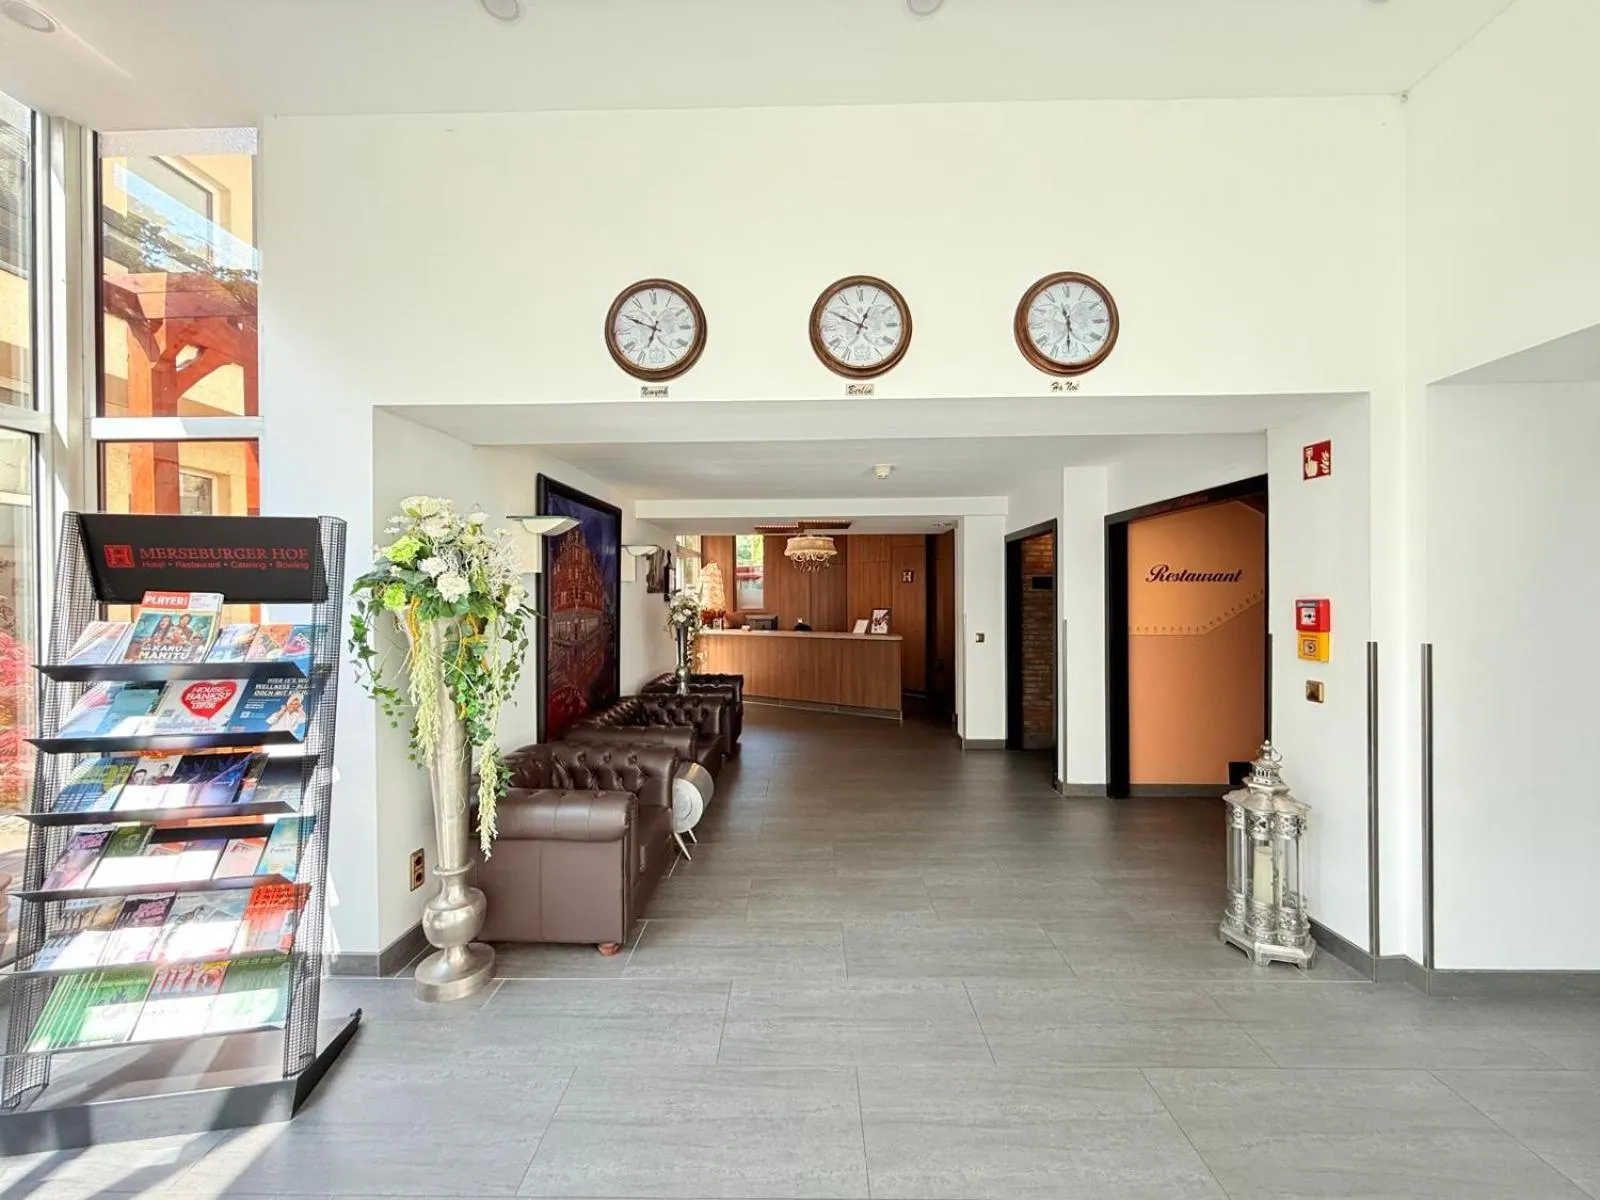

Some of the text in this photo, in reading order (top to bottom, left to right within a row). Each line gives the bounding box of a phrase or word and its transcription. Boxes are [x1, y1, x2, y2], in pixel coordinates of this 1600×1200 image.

[847, 384, 873, 395] Berlin
[139, 547, 309, 560] MERSEBURGER HOF
[142, 560, 309, 570] Hotel Restaurant Catering Bowling
[1145, 563, 1243, 583] Restaurant
[139, 651, 191, 660] MANITU
